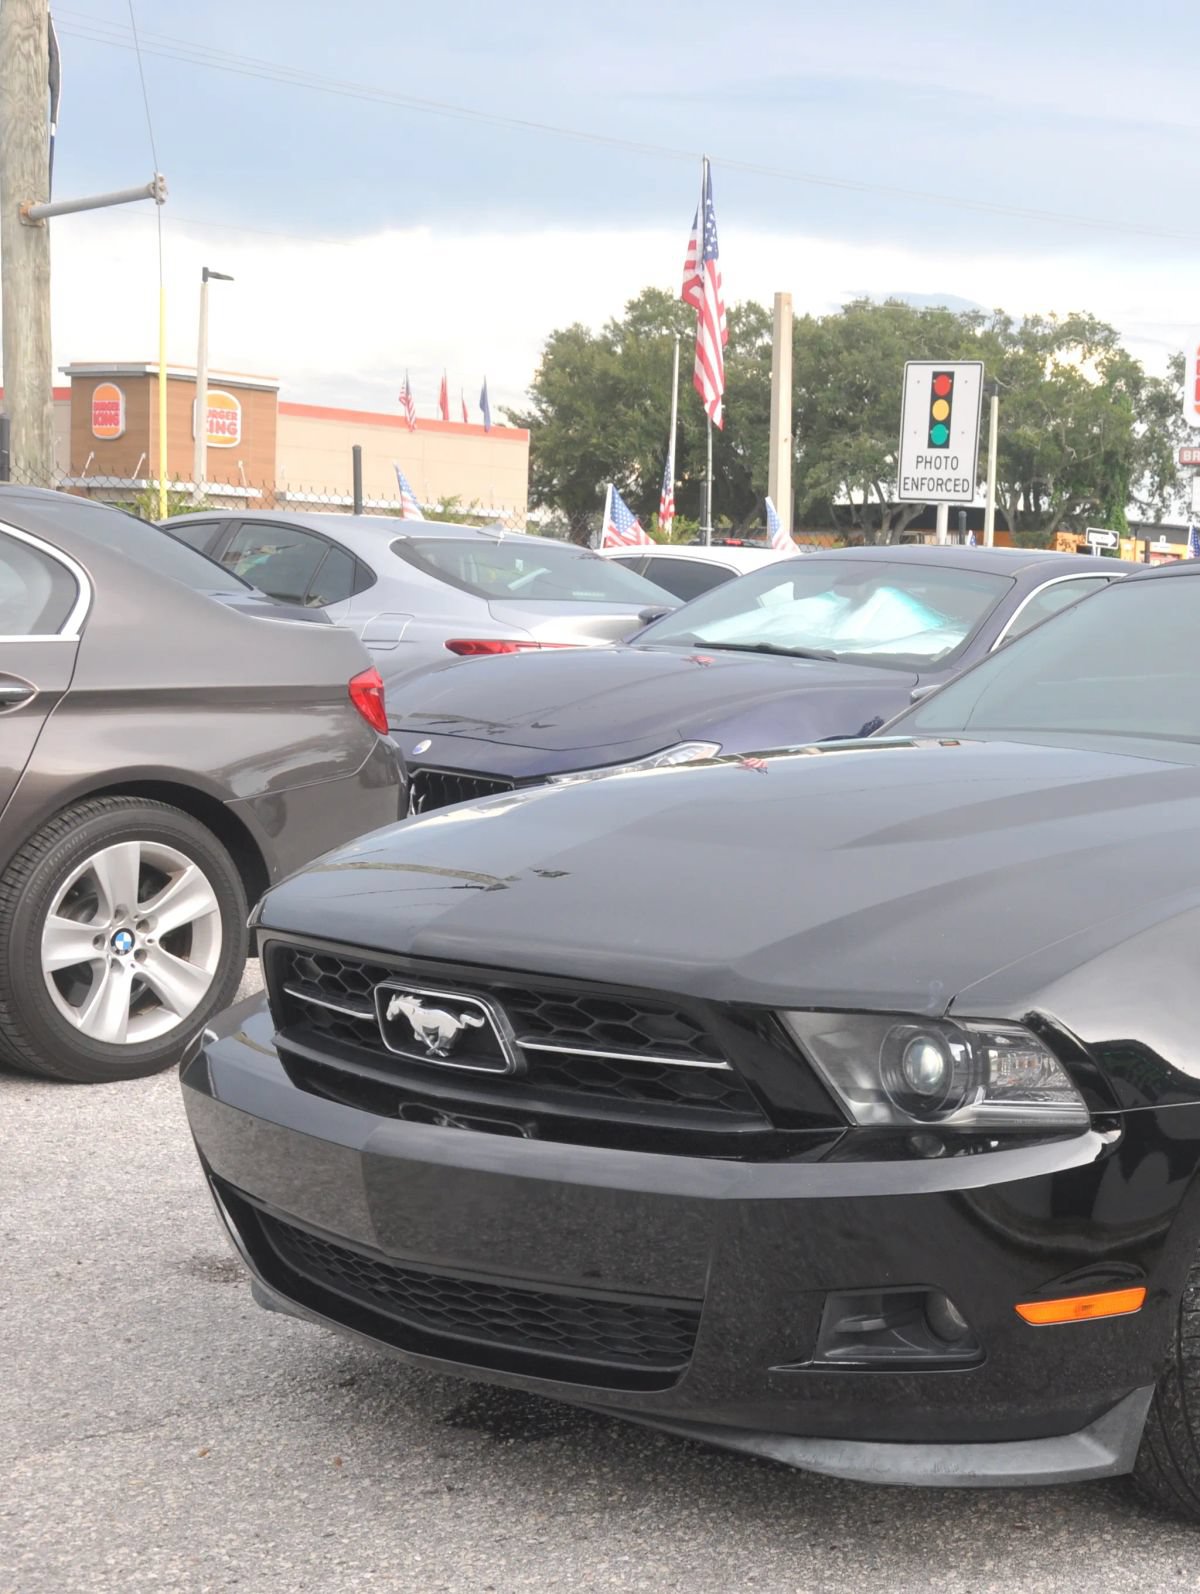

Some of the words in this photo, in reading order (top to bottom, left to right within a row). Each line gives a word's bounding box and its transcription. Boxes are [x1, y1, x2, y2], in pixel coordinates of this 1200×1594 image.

[206, 408, 238, 421] URGER
[206, 419, 238, 436] ING
[915, 455, 959, 471] PHOTO
[903, 476, 970, 493] ENFORCED
